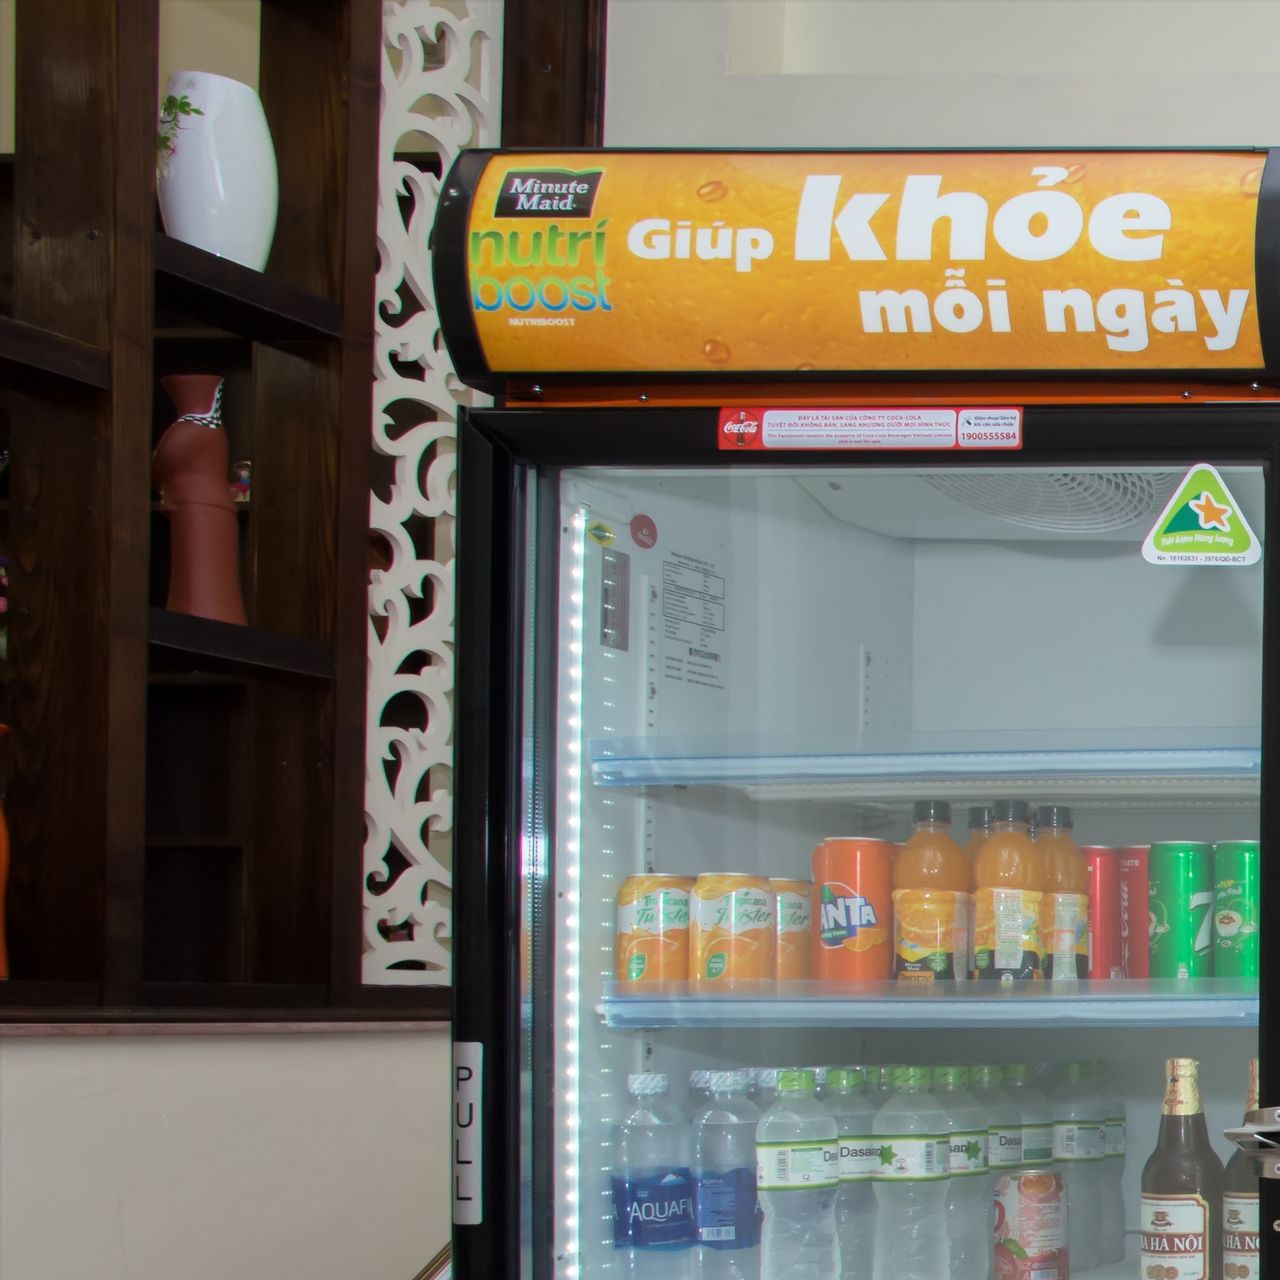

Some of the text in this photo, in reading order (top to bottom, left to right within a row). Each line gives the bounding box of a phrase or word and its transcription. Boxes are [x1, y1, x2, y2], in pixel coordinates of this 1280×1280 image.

[510, 178, 589, 195] Minute
[515, 194, 574, 211] Maid
[627, 166, 1173, 272] Giúp khỏe
[471, 269, 613, 312] boost
[859, 268, 1249, 352] mỗi ngày
[961, 432, 1016, 440] 1900555584
[820, 897, 878, 930] ANTA
[456, 1066, 474, 1201] PULL
[1151, 1234, 1169, 1251] HÀ
[1174, 1234, 1203, 1252] NỘI
